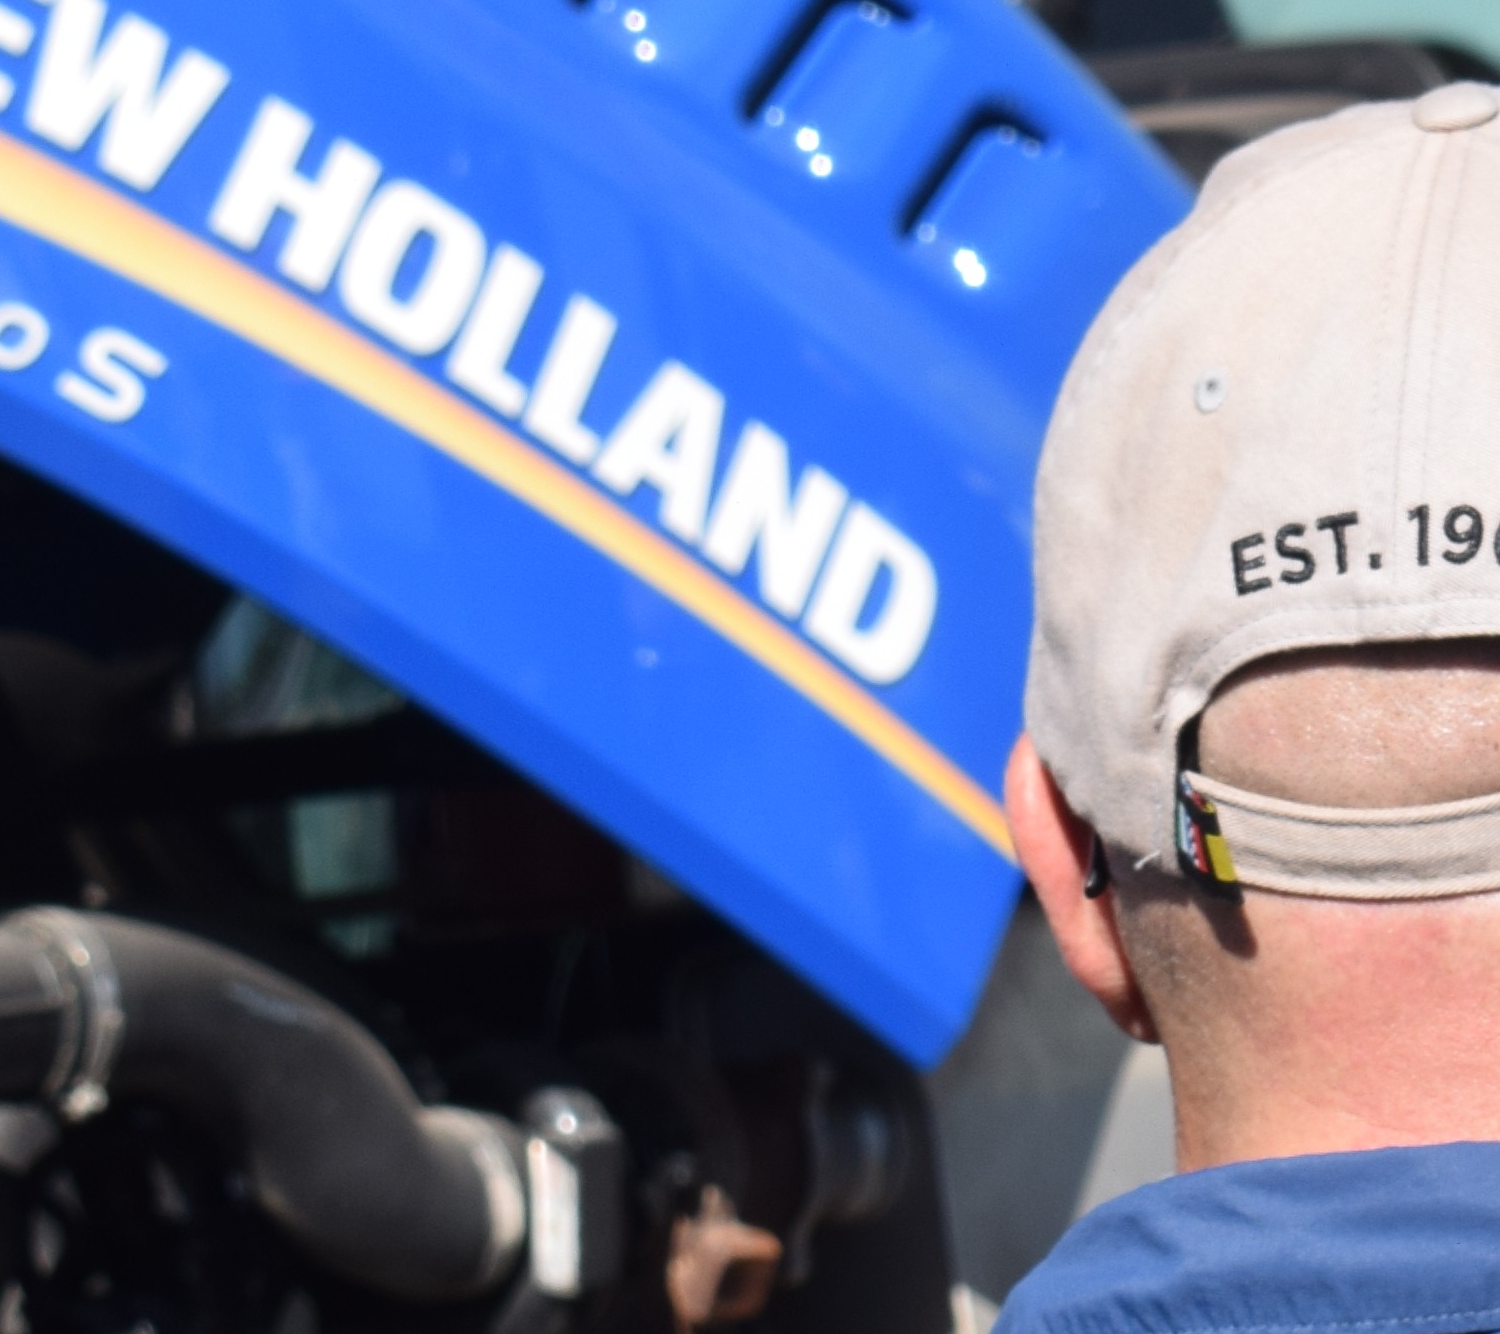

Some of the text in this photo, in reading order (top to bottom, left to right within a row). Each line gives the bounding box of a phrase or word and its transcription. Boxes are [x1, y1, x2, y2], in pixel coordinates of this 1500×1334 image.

[55, 325, 170, 425] S
[206, 95, 940, 687] HOLLAND
[1230, 511, 1383, 597] EST.
